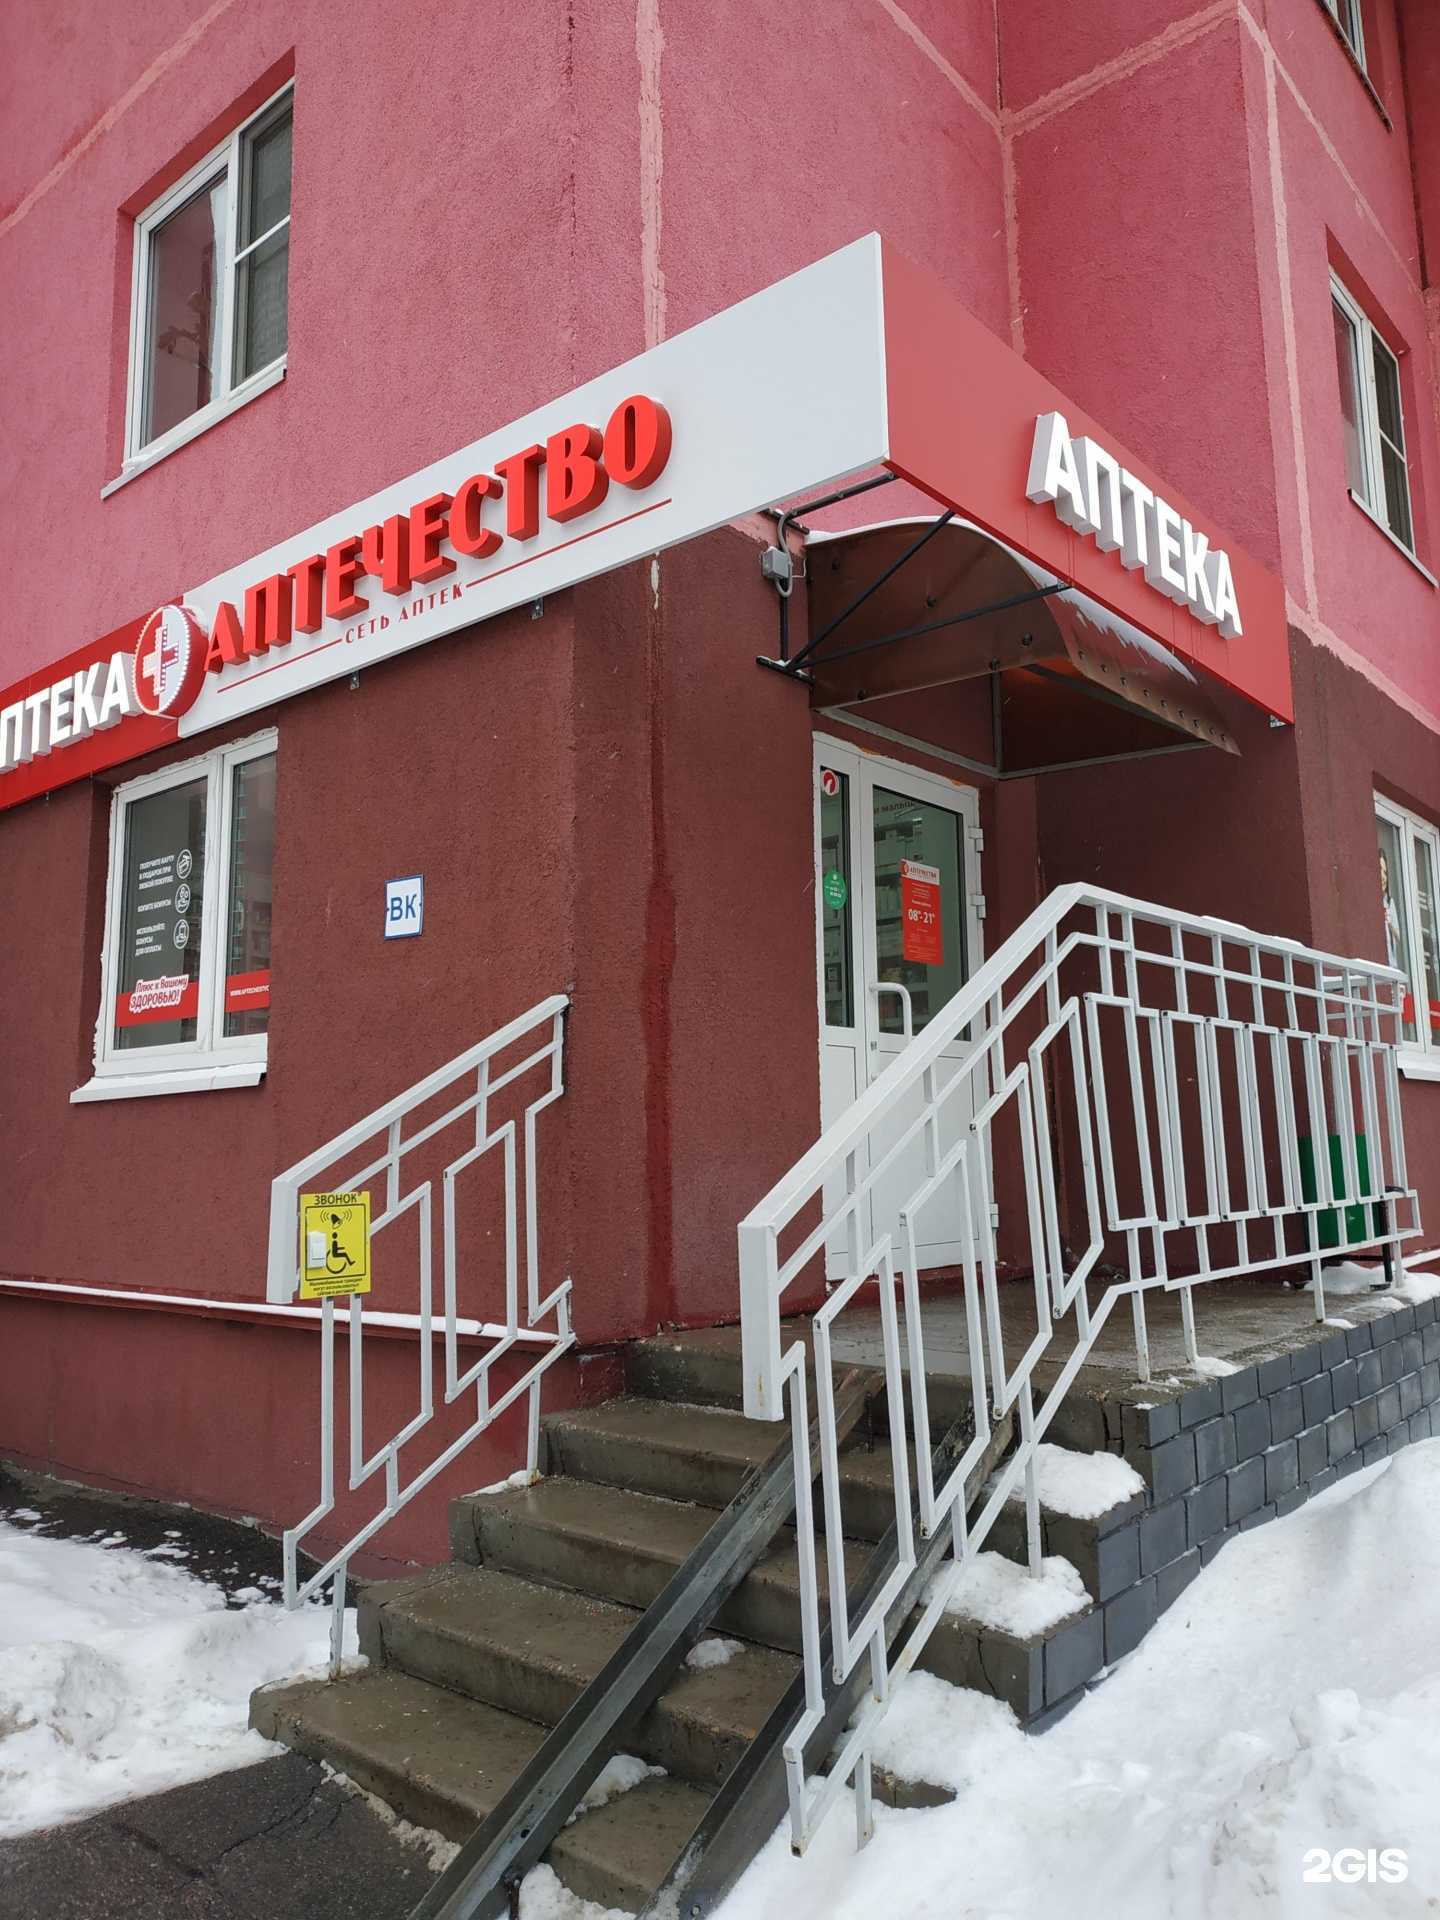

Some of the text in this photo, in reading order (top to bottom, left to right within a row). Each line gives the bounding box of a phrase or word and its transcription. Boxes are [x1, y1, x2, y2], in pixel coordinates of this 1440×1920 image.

[202, 394, 672, 674] АПТЕЧЕСТВО
[1026, 411, 1243, 640] АПТЕКА
[345, 582, 463, 643] СЕТЬ АПТЕК
[130, 989, 180, 1010] ЗДОРОВЬЮ!
[136, 981, 153, 992] Плюс
[160, 976, 188, 989] Вашему
[314, 1193, 357, 1205] ЗВОНОК
